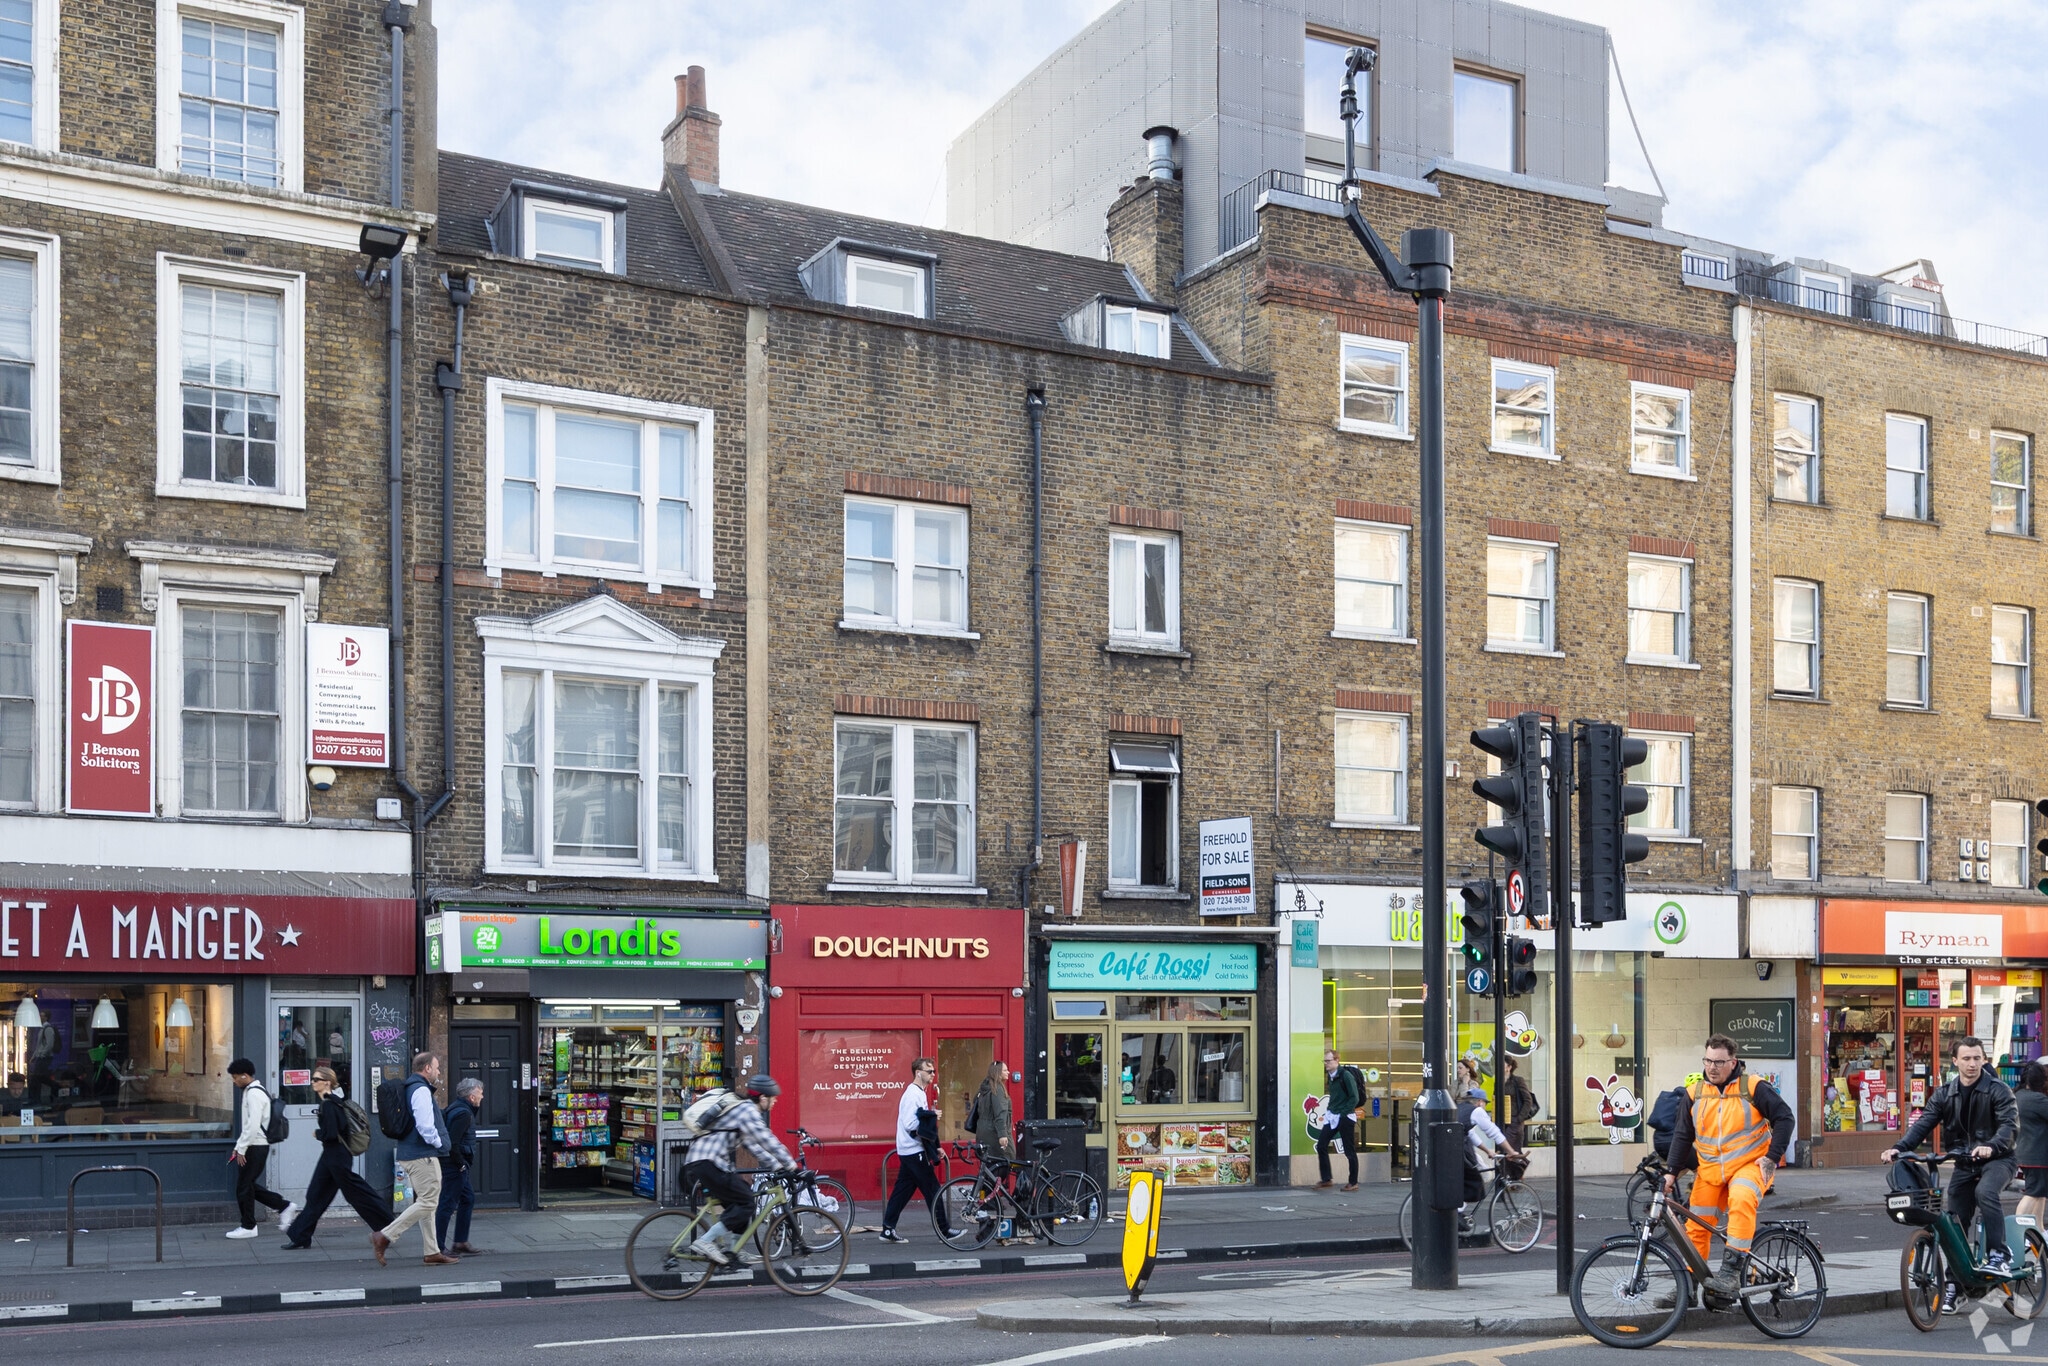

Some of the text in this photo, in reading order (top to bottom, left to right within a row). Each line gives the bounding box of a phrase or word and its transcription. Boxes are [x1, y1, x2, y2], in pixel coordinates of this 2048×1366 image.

[346, 668, 378, 678] Solicitors
[81, 677, 135, 722] JB
[318, 692, 362, 700] Conveyancing
[81, 742, 140, 757] J Benson
[315, 744, 382, 756] 0207 625 4300
[81, 756, 140, 769] Solicitors
[1203, 832, 1247, 846] FREEHOLD
[1966, 841, 1972, 854] C
[1982, 842, 1988, 855] C
[1202, 850, 1249, 866] FOR SALE
[1965, 863, 1971, 876] C
[1982, 865, 1988, 878] C
[1204, 879, 1224, 888] FIELD
[1228, 877, 1248, 886] SONS
[461, 914, 517, 924] ondon Bridge
[65, 904, 90, 958] A
[112, 905, 265, 961] MANGER
[540, 916, 681, 956] Londis
[1296, 924, 1313, 936] Café
[476, 931, 498, 945] 24
[1296, 939, 1314, 950] Rossi
[1899, 930, 1990, 948] Ryman
[814, 936, 990, 959] DOUGHNUTS
[1057, 951, 1094, 960] Cappuccino
[1899, 956, 1990, 965] the stationer
[1057, 961, 1085, 969] Espresso
[1100, 951, 1211, 981] Café Rossi
[1728, 1018, 1775, 1032] GEORGE
